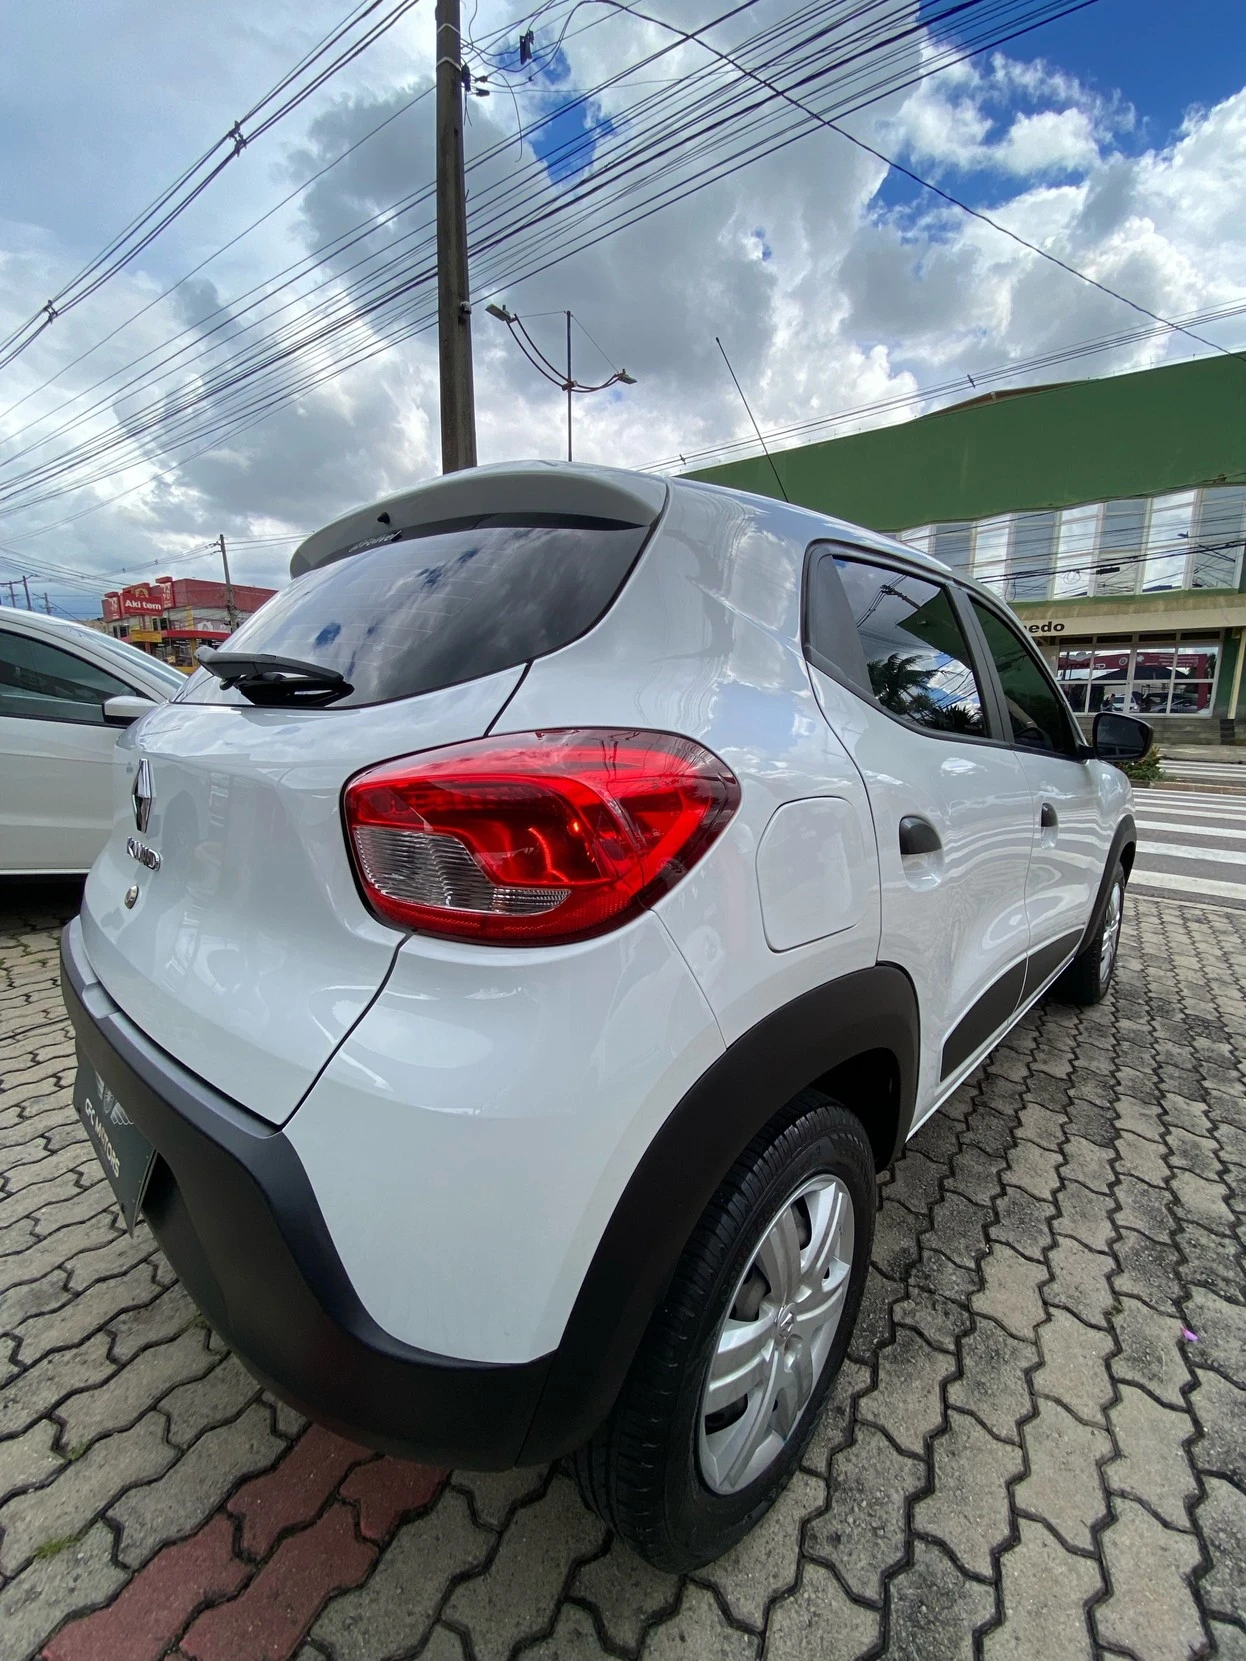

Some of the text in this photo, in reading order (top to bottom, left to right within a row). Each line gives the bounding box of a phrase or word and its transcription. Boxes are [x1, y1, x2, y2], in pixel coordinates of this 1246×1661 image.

[125, 600, 161, 610] Aki tem
[1023, 621, 1065, 633] edo
[95, 1116, 120, 1178] MOTORS
